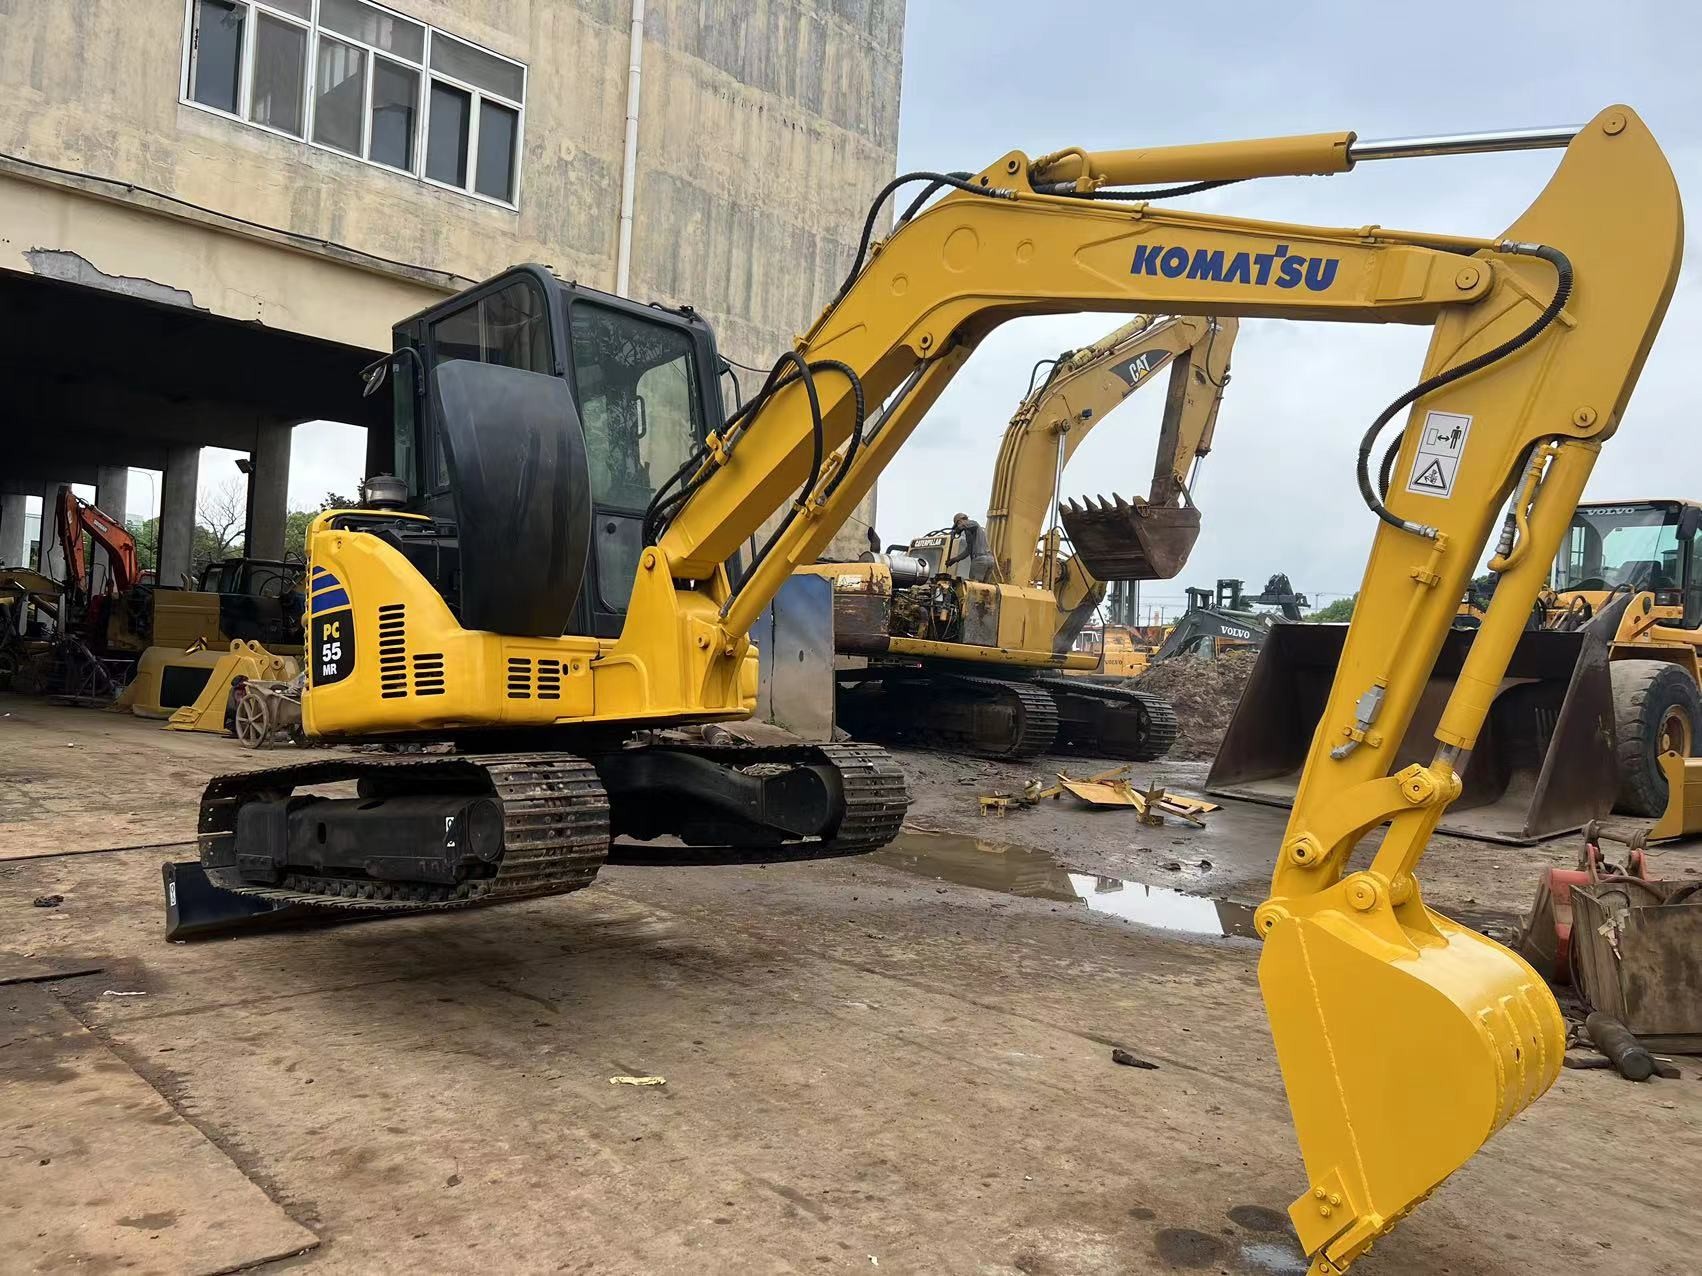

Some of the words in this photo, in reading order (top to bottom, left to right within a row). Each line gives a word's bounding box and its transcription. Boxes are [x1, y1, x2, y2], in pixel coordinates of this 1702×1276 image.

[1130, 244, 1339, 291] KOMATSU
[1129, 353, 1150, 382] CAT
[1586, 507, 1635, 516] VOLVO
[323, 621, 340, 641] PC
[1220, 625, 1250, 639] VOLVO
[322, 641, 342, 662] 55
[322, 663, 337, 676] MR
